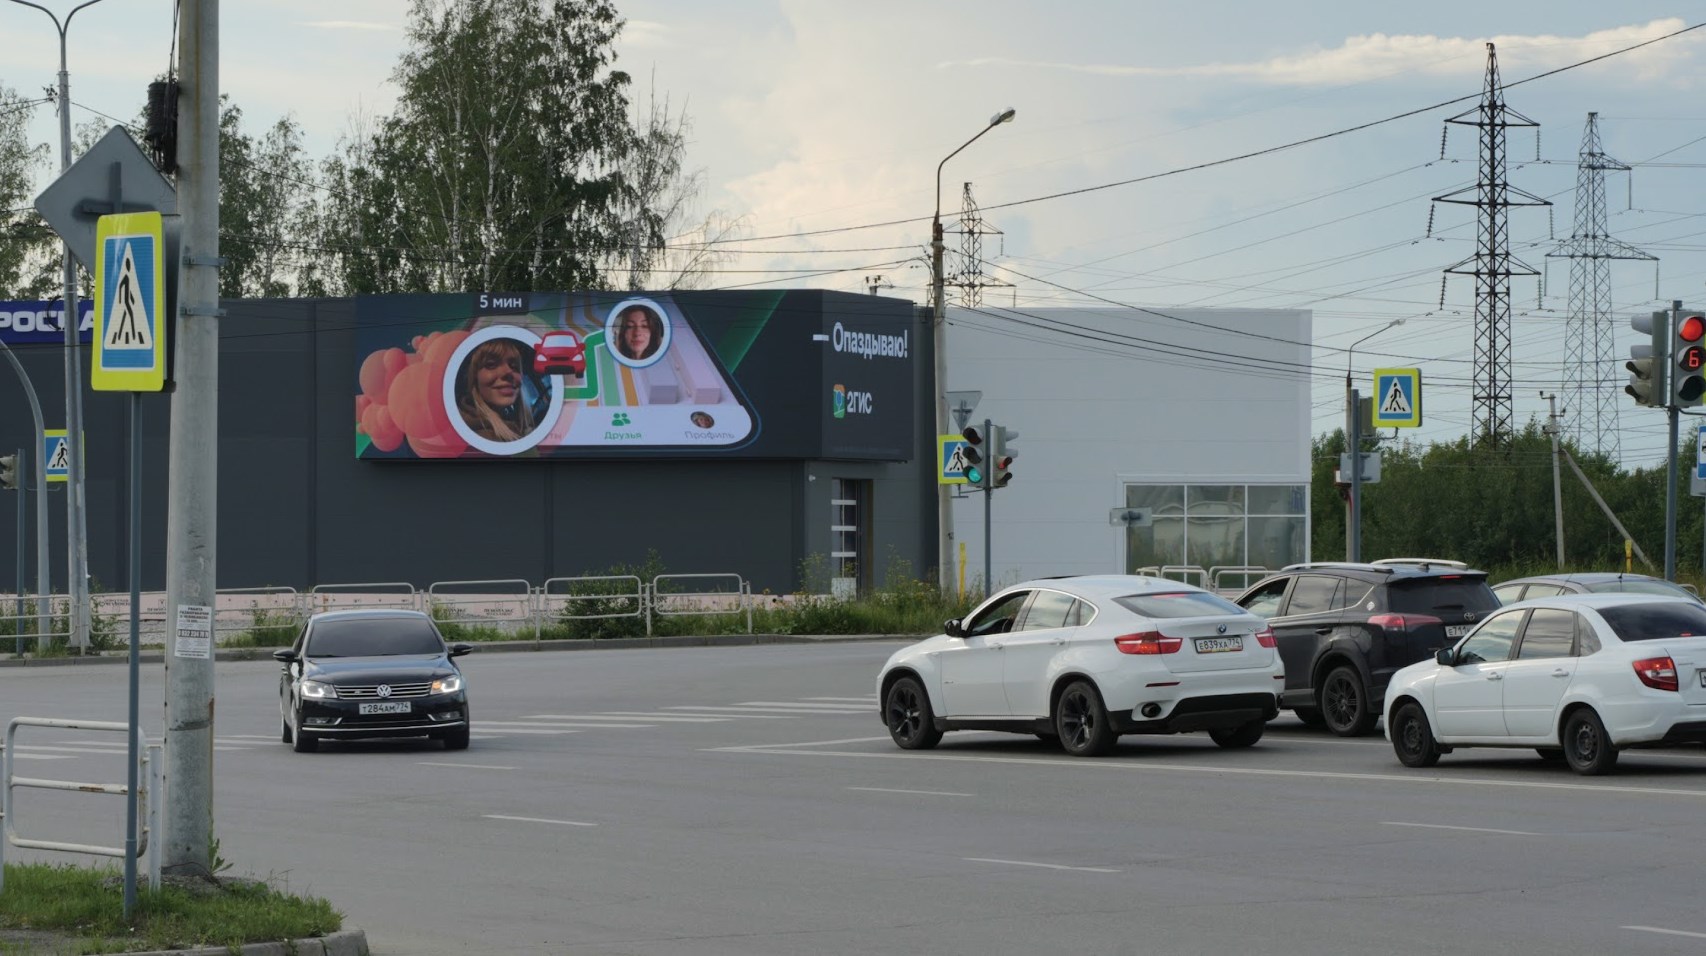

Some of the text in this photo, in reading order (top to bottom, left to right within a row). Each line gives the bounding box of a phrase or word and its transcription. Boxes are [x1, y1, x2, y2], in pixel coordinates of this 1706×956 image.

[480, 294, 523, 308] 5 мин
[833, 321, 908, 360] Опаздываю!
[1689, 350, 1699, 366] 6
[846, 391, 872, 414] 2ГИС
[604, 431, 642, 440] Друзья
[685, 430, 735, 440] Профиль
